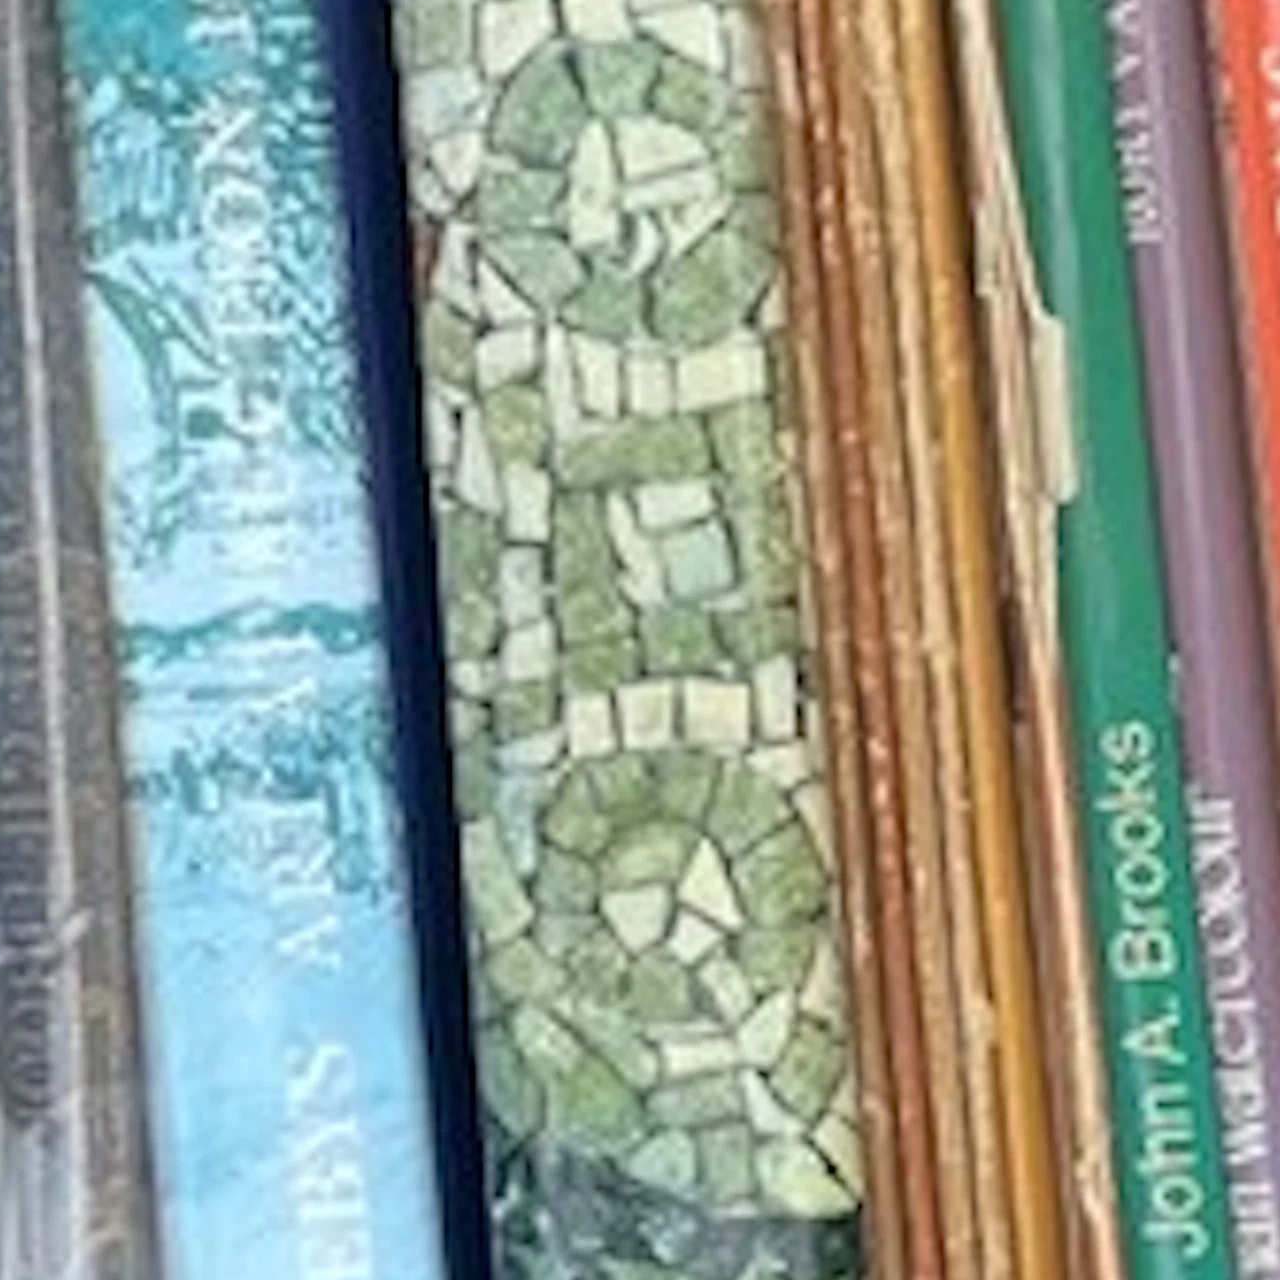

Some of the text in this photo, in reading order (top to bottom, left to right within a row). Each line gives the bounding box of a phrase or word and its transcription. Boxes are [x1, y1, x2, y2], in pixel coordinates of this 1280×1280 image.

[265, 794, 345, 970] ART
[1098, 720, 1178, 983] Brooks
[1123, 1002, 1184, 1064] A.
[1132, 1080, 1206, 1258] John
